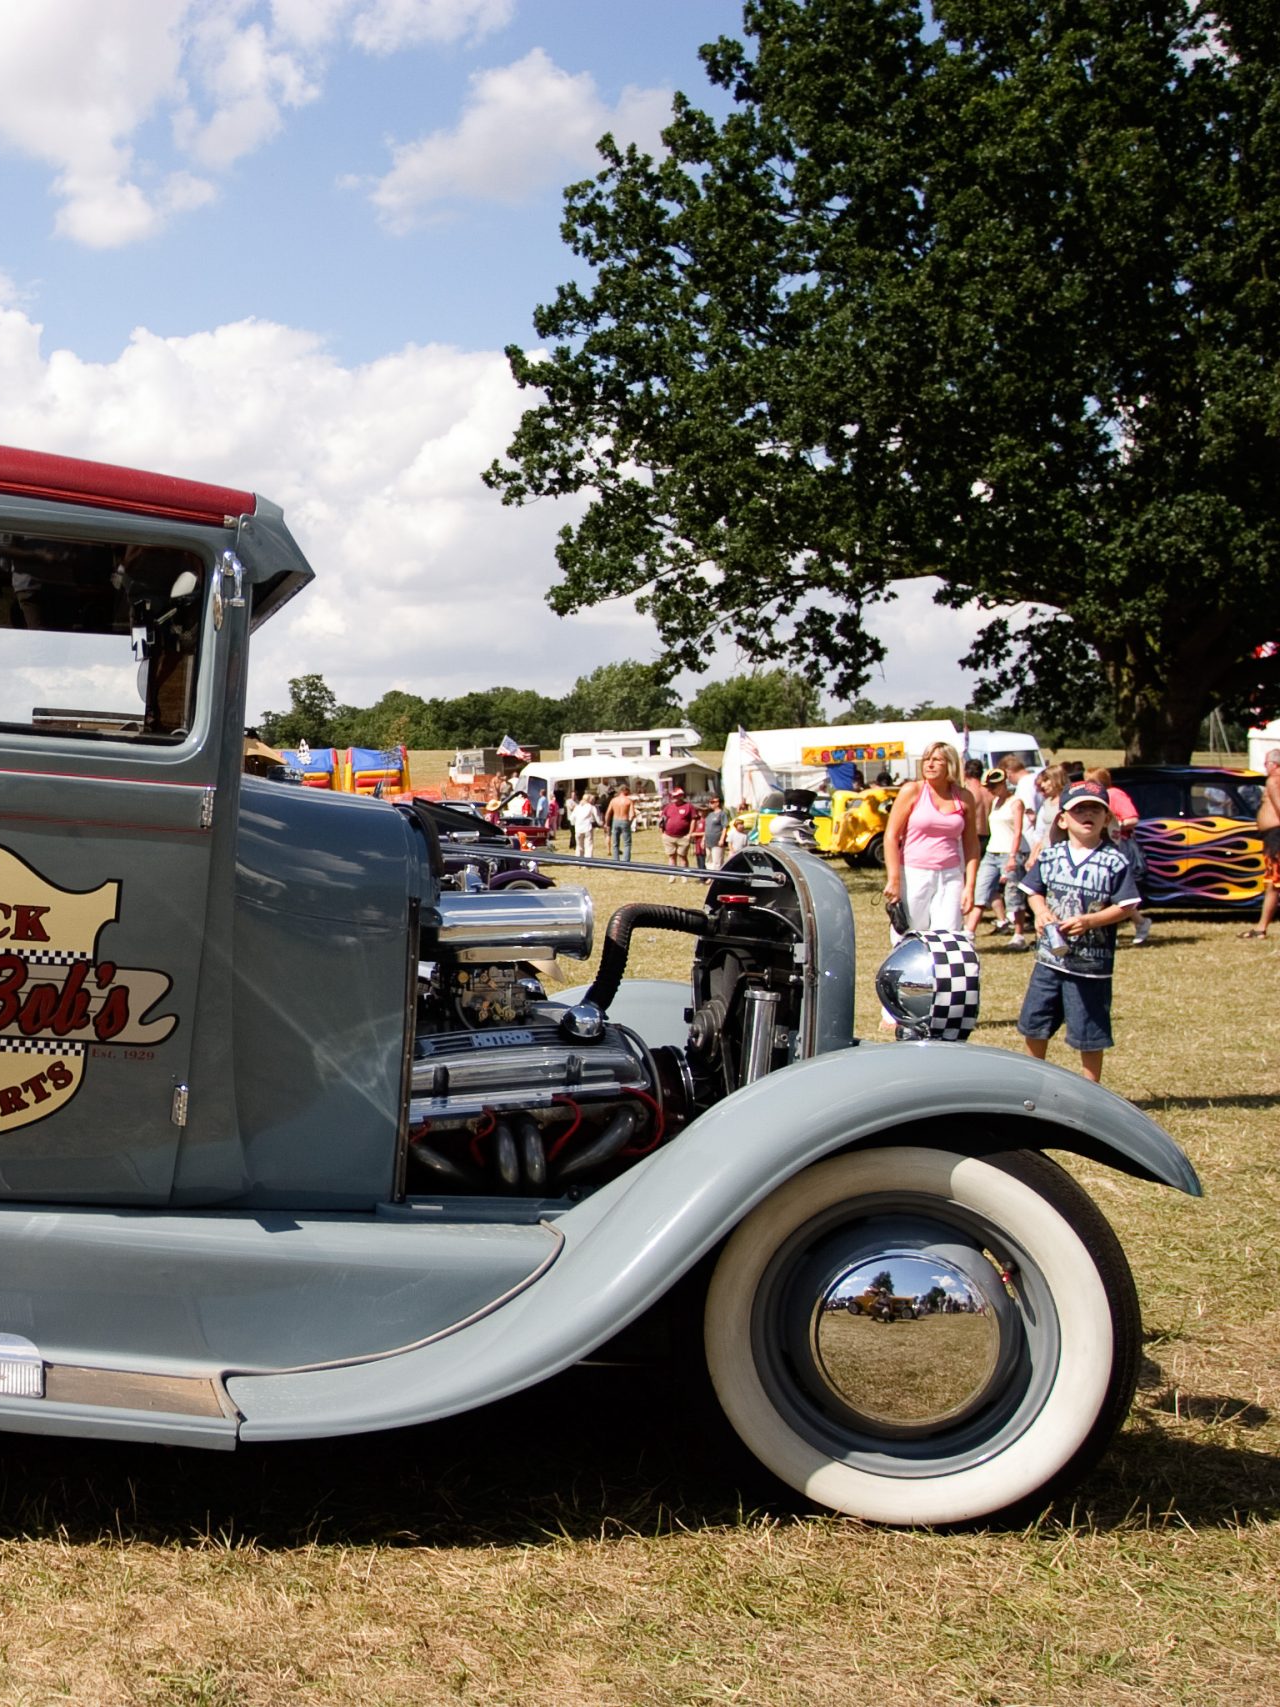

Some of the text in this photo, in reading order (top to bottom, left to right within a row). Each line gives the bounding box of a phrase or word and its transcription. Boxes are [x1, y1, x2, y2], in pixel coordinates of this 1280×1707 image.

[821, 746, 886, 763] SWEETS
[91, 1046, 155, 1061] Est. 1929
